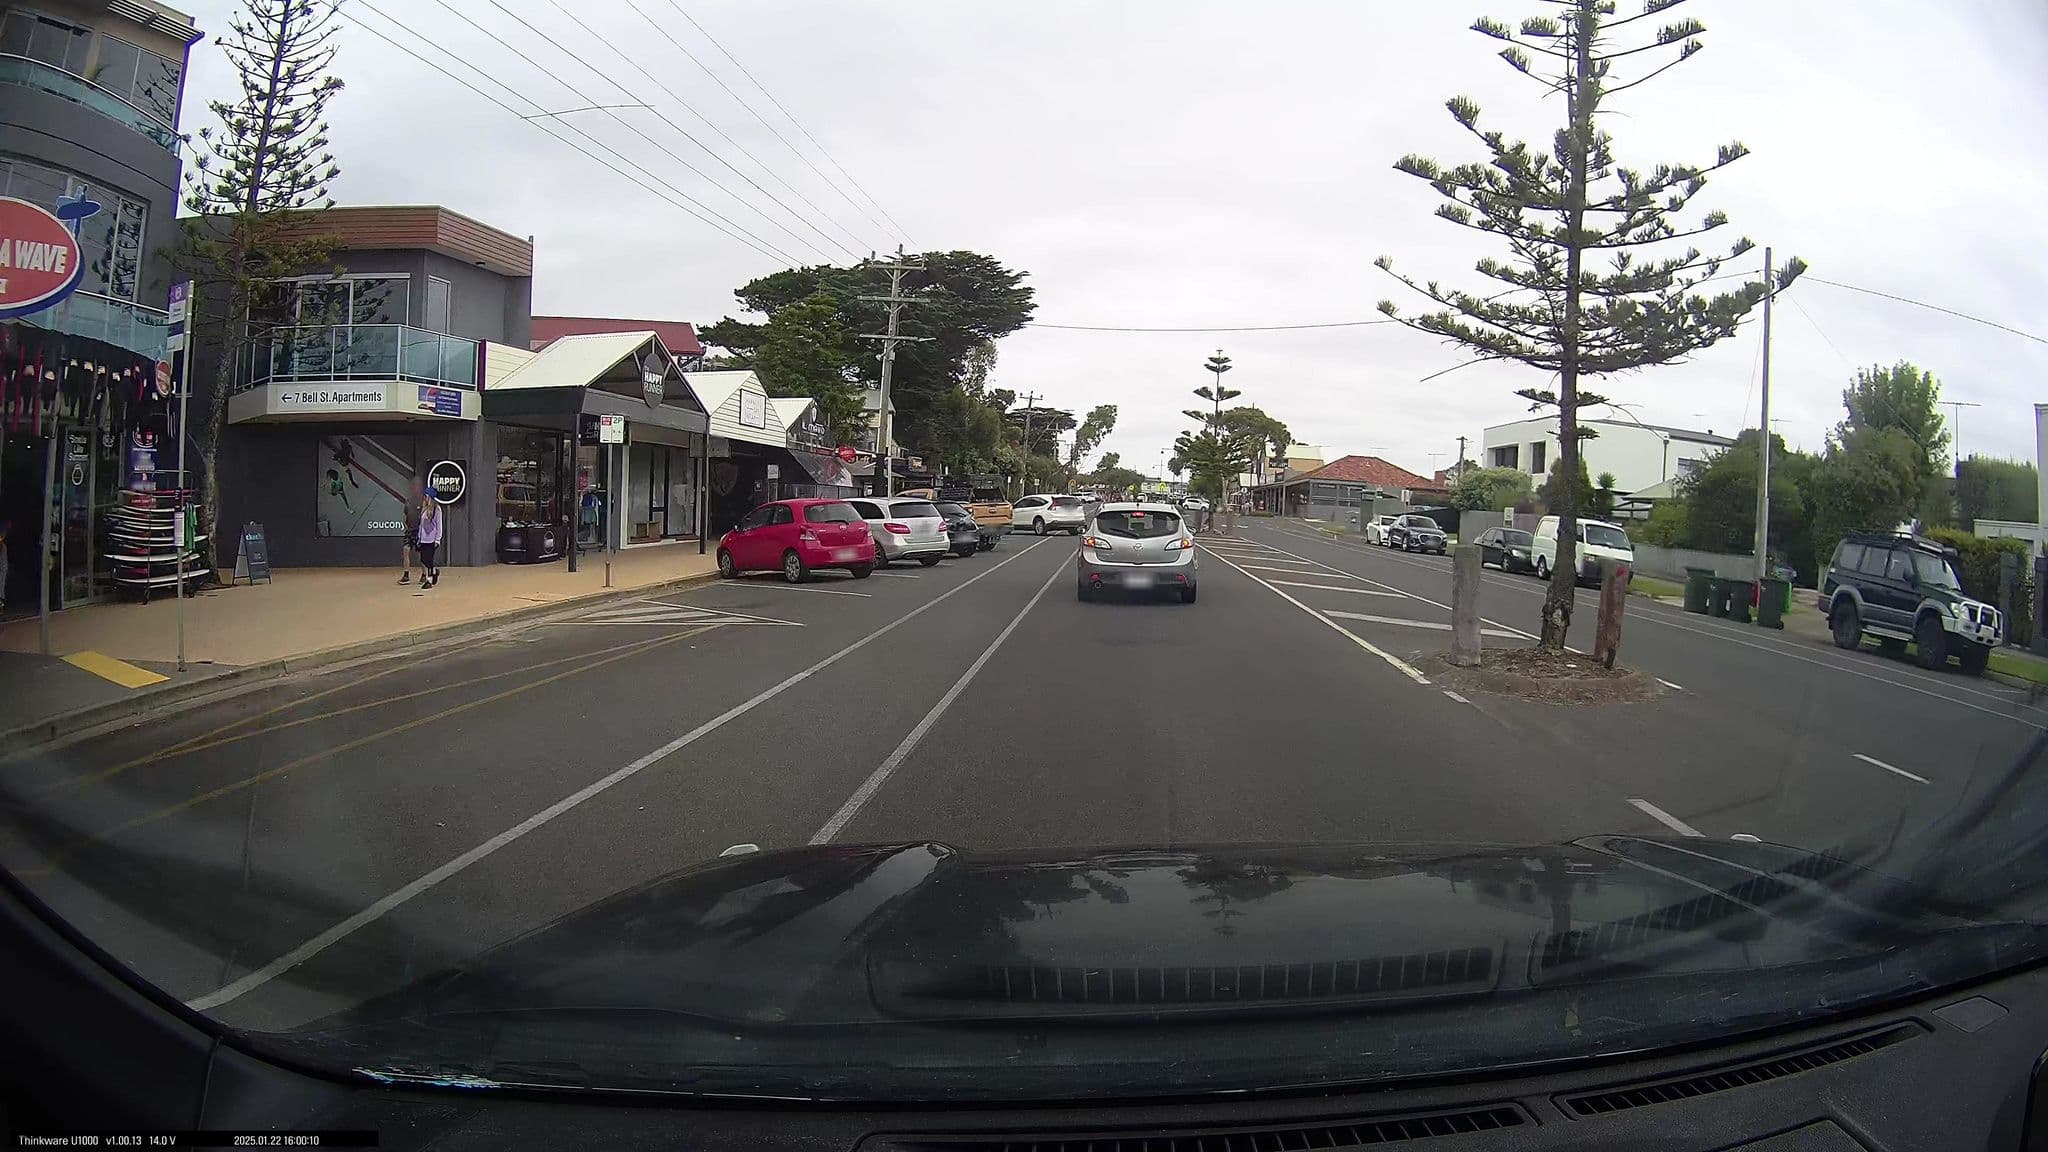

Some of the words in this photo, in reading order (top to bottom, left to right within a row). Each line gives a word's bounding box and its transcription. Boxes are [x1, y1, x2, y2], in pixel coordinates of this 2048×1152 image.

[15, 239, 68, 274] WAVE
[644, 371, 663, 385] HAPPY
[643, 382, 663, 395] RUNNER
[294, 392, 300, 403] 7
[302, 391, 318, 403] Bell
[332, 391, 382, 405] Apartments
[432, 476, 460, 485] HAPPY
[435, 484, 461, 493] UNNER
